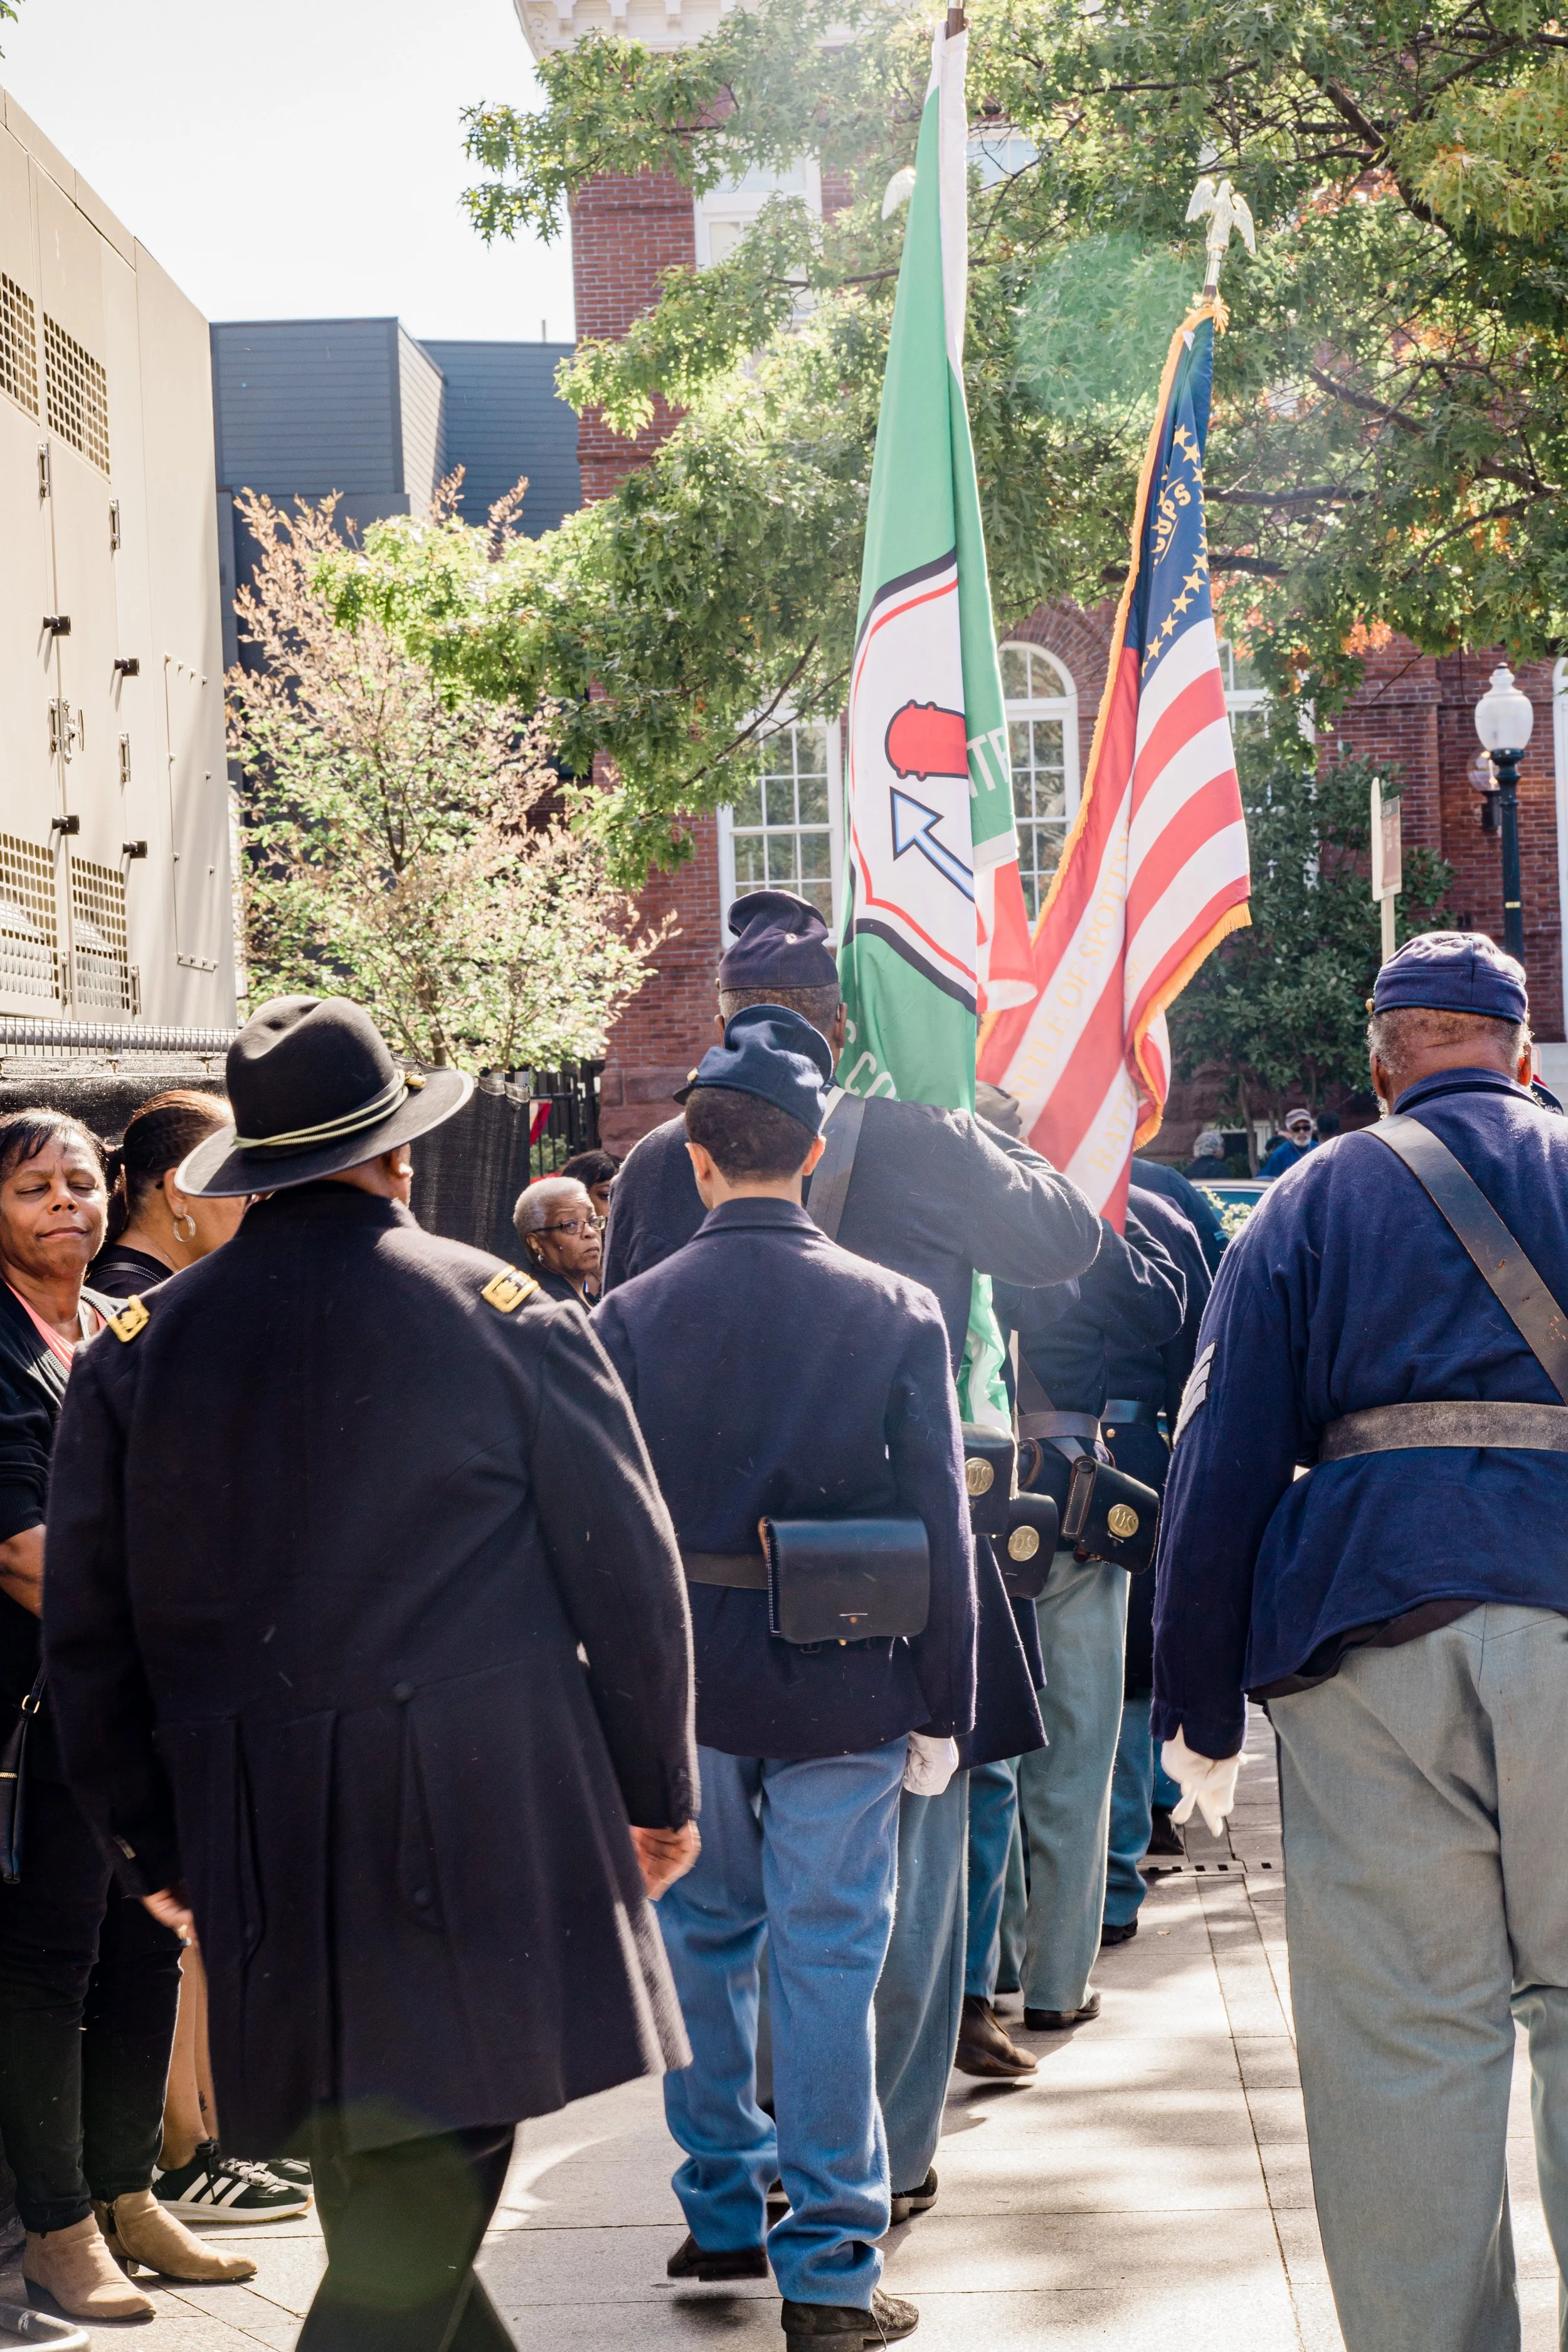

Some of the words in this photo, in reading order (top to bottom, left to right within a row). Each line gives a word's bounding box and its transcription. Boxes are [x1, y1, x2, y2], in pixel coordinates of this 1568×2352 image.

[1007, 1009, 1069, 1111] ATTLE
[1056, 961, 1090, 1007] OF
[967, 1465, 990, 1488] US
[1115, 1508, 1138, 1532] US
[1013, 1534, 1036, 1554] US
